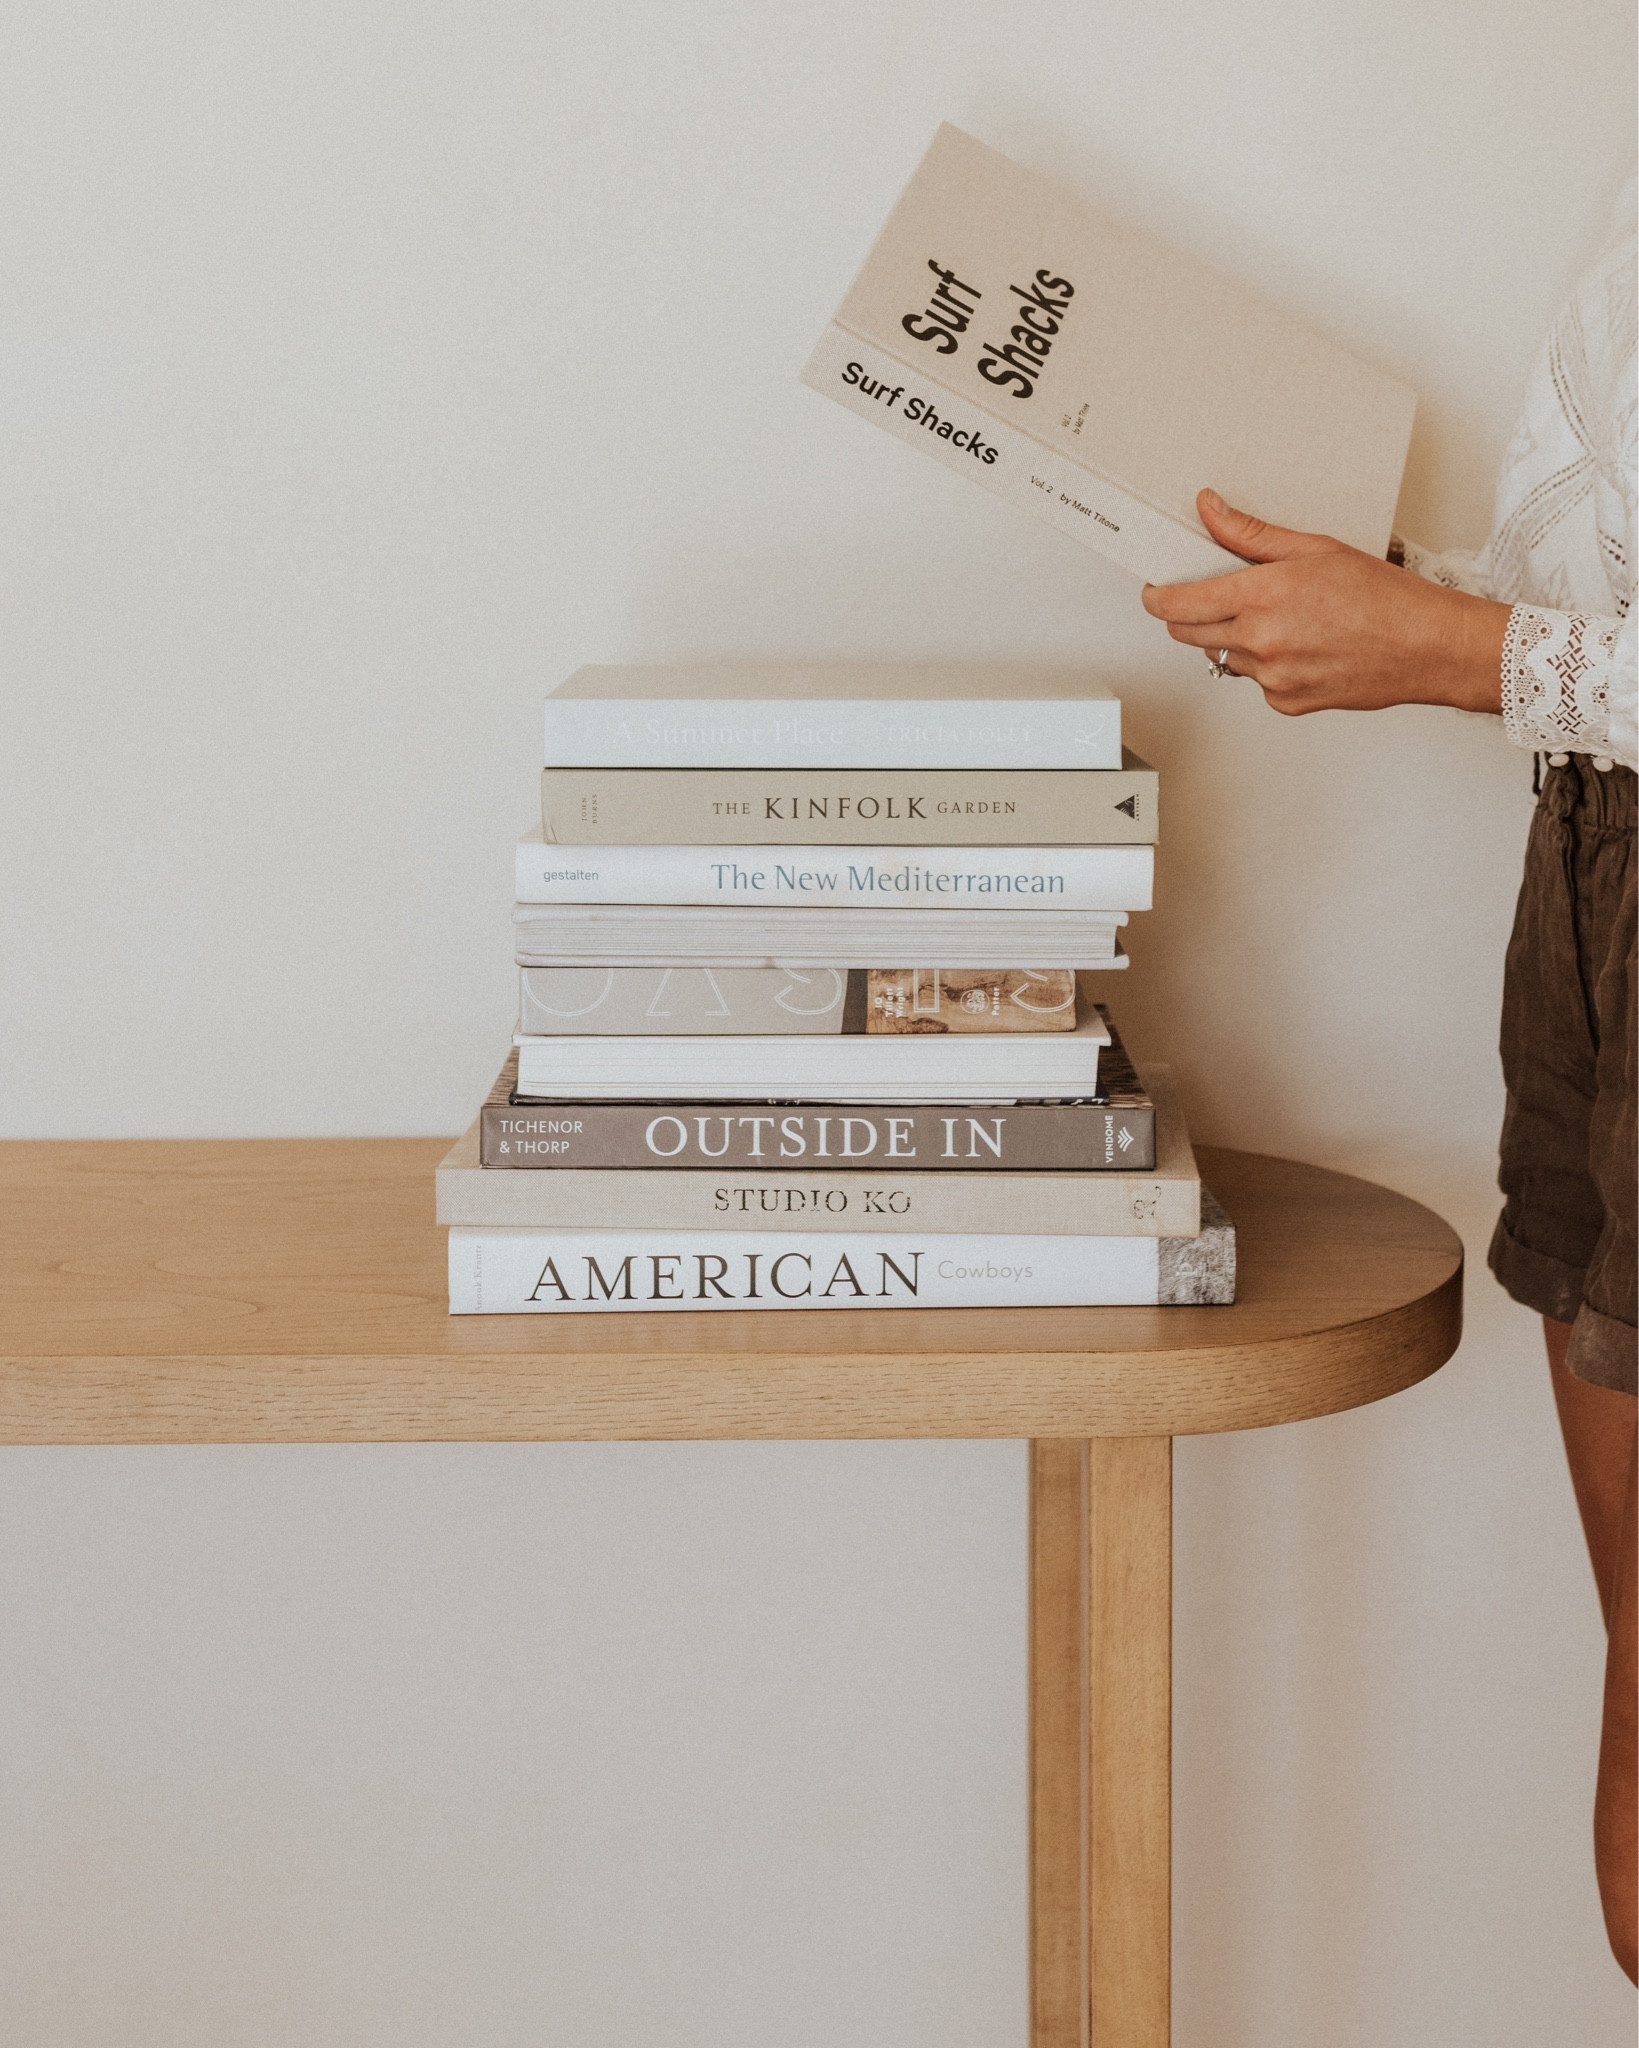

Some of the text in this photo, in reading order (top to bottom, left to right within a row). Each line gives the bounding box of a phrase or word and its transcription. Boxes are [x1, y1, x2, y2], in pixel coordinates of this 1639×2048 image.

[901, 259, 982, 355] Surf
[977, 269, 1075, 399] Shacks
[841, 362, 999, 465] Surf Shacks
[1046, 485, 1054, 494] 2
[1060, 493, 1120, 532] by Matt Titone
[772, 717, 844, 745] Place
[712, 796, 1017, 820] THE KINFOLK GARDEN
[543, 869, 599, 883] gestalten
[710, 864, 1065, 894] The New Mediterranean
[991, 986, 1000, 1016] Potter
[499, 1120, 584, 1134] TICHENOR
[645, 1115, 1007, 1158] OUTSIDE IN
[1104, 1115, 1114, 1163] VENDOME
[499, 1140, 571, 1154] & THORP
[714, 1188, 912, 1214] STUDIO KO
[524, 1252, 1034, 1301] AMERICAN Cowboys
